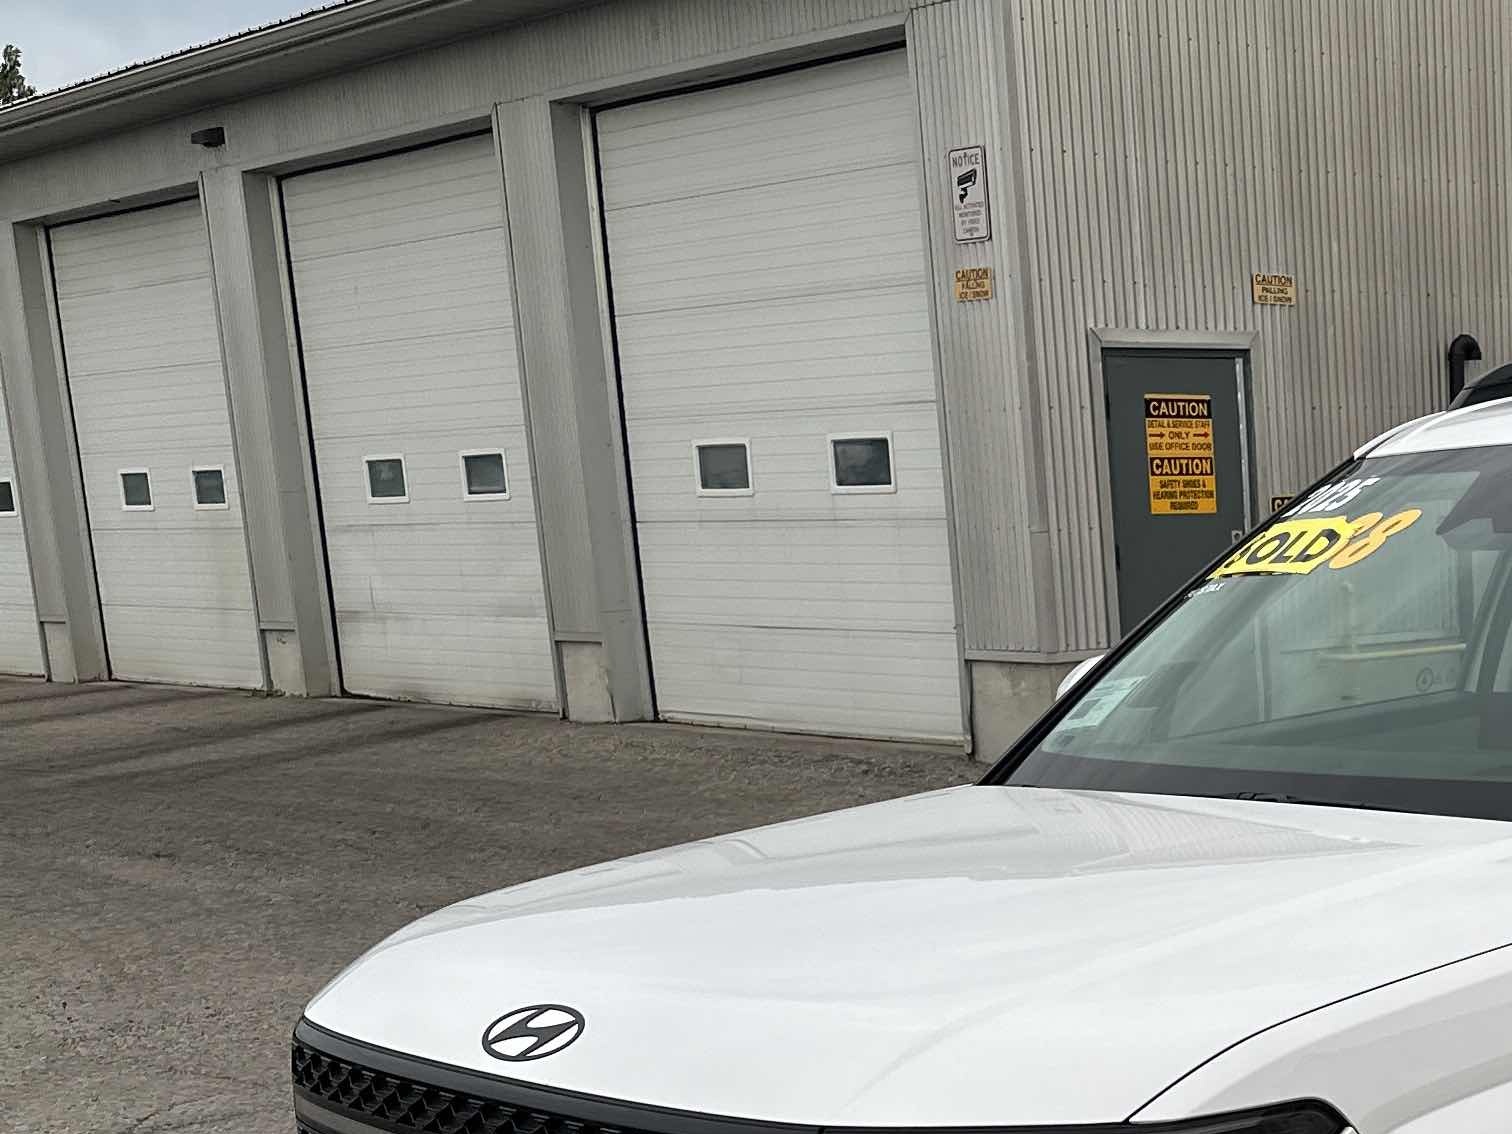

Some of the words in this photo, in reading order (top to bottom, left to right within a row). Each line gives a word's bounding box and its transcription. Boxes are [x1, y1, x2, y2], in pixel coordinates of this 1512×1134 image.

[952, 153, 981, 168] NOTICE
[955, 268, 989, 281] CAUTION
[1255, 273, 1293, 285] CAUTION
[1150, 400, 1208, 416] CAUTION
[1168, 430, 1191, 440] ONLY
[1149, 442, 1163, 450] USE
[1165, 442, 1191, 450] OFFICE
[1192, 443, 1212, 451] DOOR
[1152, 458, 1212, 475] CAUTION
